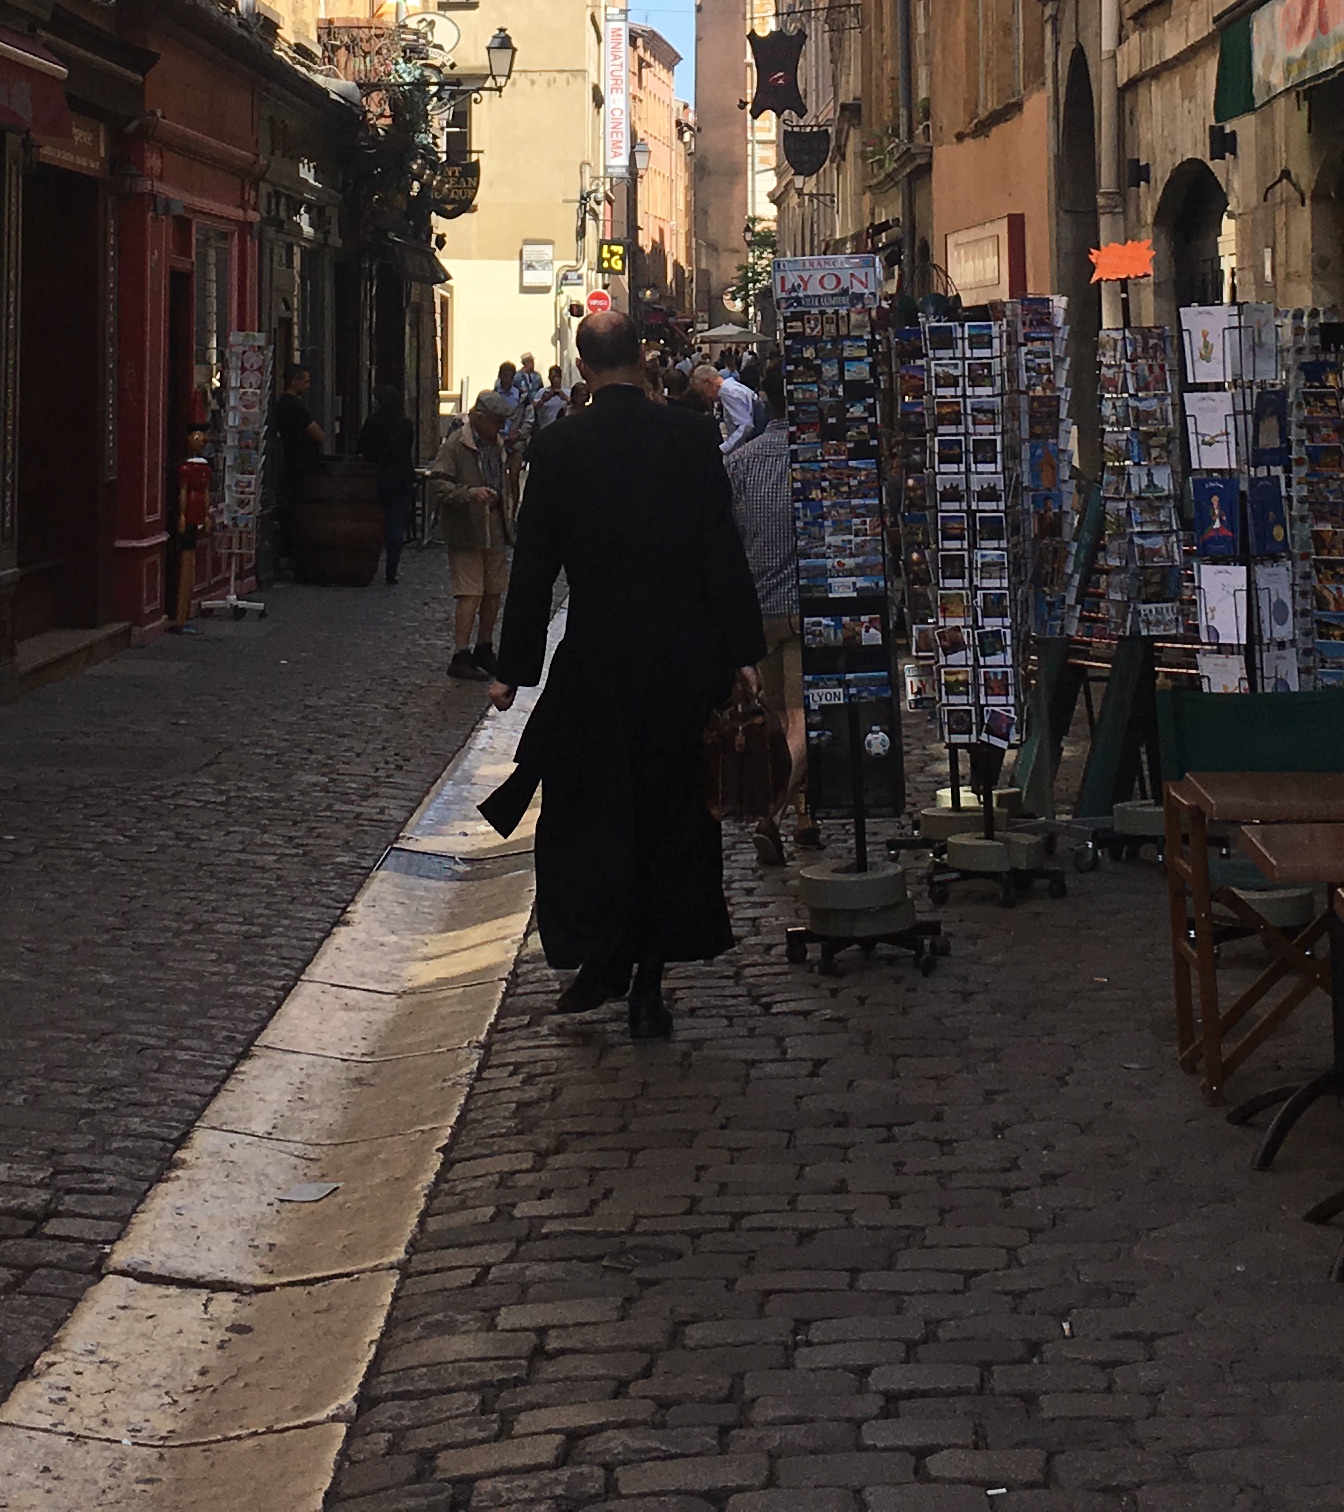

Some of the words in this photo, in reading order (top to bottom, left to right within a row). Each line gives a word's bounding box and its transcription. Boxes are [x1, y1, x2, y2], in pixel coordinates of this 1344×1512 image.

[609, 27, 624, 95] MINIATURE
[609, 107, 624, 159] CINEMA
[780, 271, 869, 293] LYON
[811, 691, 842, 703] LYON
